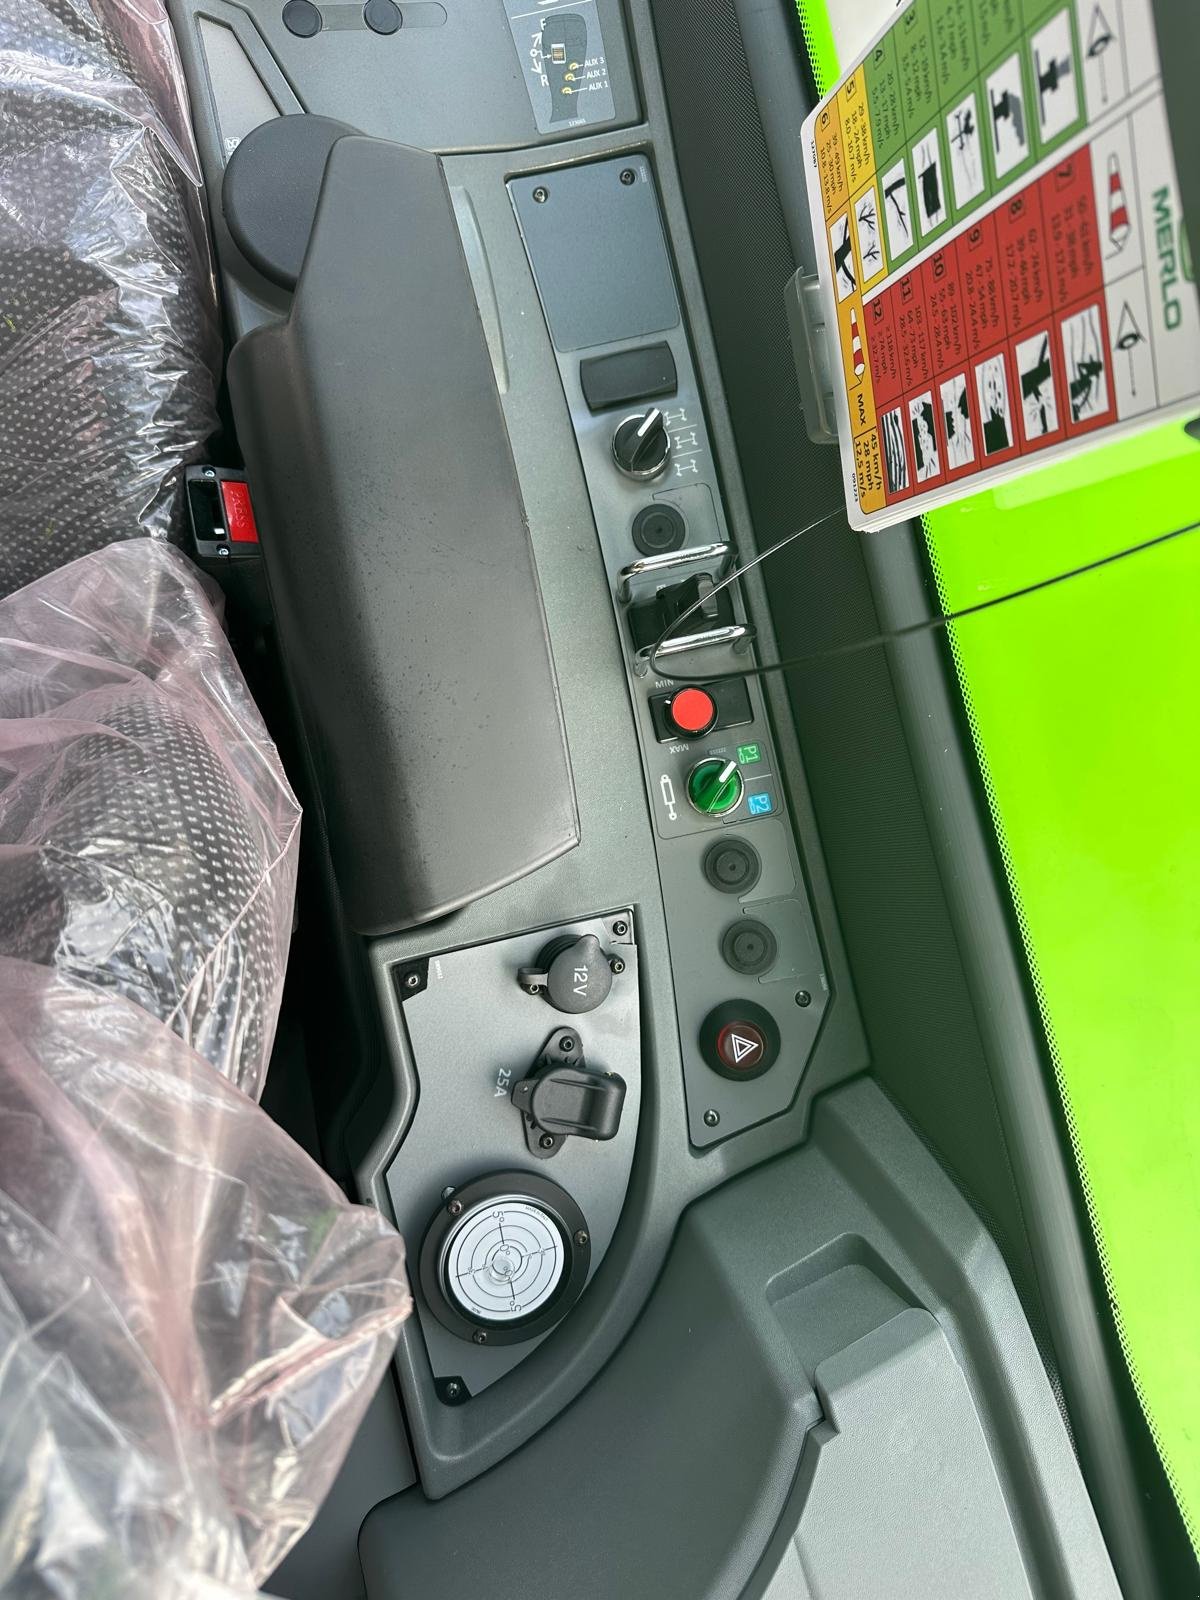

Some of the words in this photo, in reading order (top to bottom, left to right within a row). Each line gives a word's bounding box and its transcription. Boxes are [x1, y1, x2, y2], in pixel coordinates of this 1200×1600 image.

[540, 18, 547, 30] F
[585, 59, 598, 68] AUX
[874, 46, 882, 61] 4
[540, 74, 549, 87] R
[587, 71, 600, 79] AUX
[589, 83, 602, 91] AUX
[846, 80, 854, 95] 5
[821, 111, 828, 124] 6
[851, 110, 857, 124] 18
[858, 102, 864, 117] 29
[853, 129, 859, 144] 24
[860, 122, 866, 137] 38
[853, 143, 862, 170] mph
[862, 135, 870, 165] km/h
[828, 171, 836, 196] mph
[835, 164, 843, 192] km/h
[1009, 198, 1023, 215] 8
[969, 228, 980, 243] 9
[933, 253, 944, 278] 10
[1150, 185, 1182, 332] MERLO
[901, 277, 911, 300] 11
[872, 298, 881, 319] 12
[978, 301, 988, 329] mph
[988, 294, 999, 328] km/h
[942, 324, 951, 350] mph
[951, 325, 961, 355] km/h
[971, 326, 980, 350] m/s
[910, 344, 918, 368] mph
[920, 351, 928, 379] km/h
[935, 347, 944, 369] m/s
[904, 366, 912, 387] m/s
[857, 393, 865, 425] MAX
[863, 440, 869, 456] 28
[870, 432, 877, 449] 45
[854, 440, 863, 468] 12,5
[864, 459, 874, 490] mph
[872, 453, 882, 490] km/h
[858, 471, 866, 497] m/s
[655, 680, 674, 688] MIN
[669, 744, 689, 754] MAX
[743, 745, 758, 763] P1
[755, 795, 772, 813] P2
[573, 965, 588, 997] 12V
[494, 1067, 512, 1098] 25A
